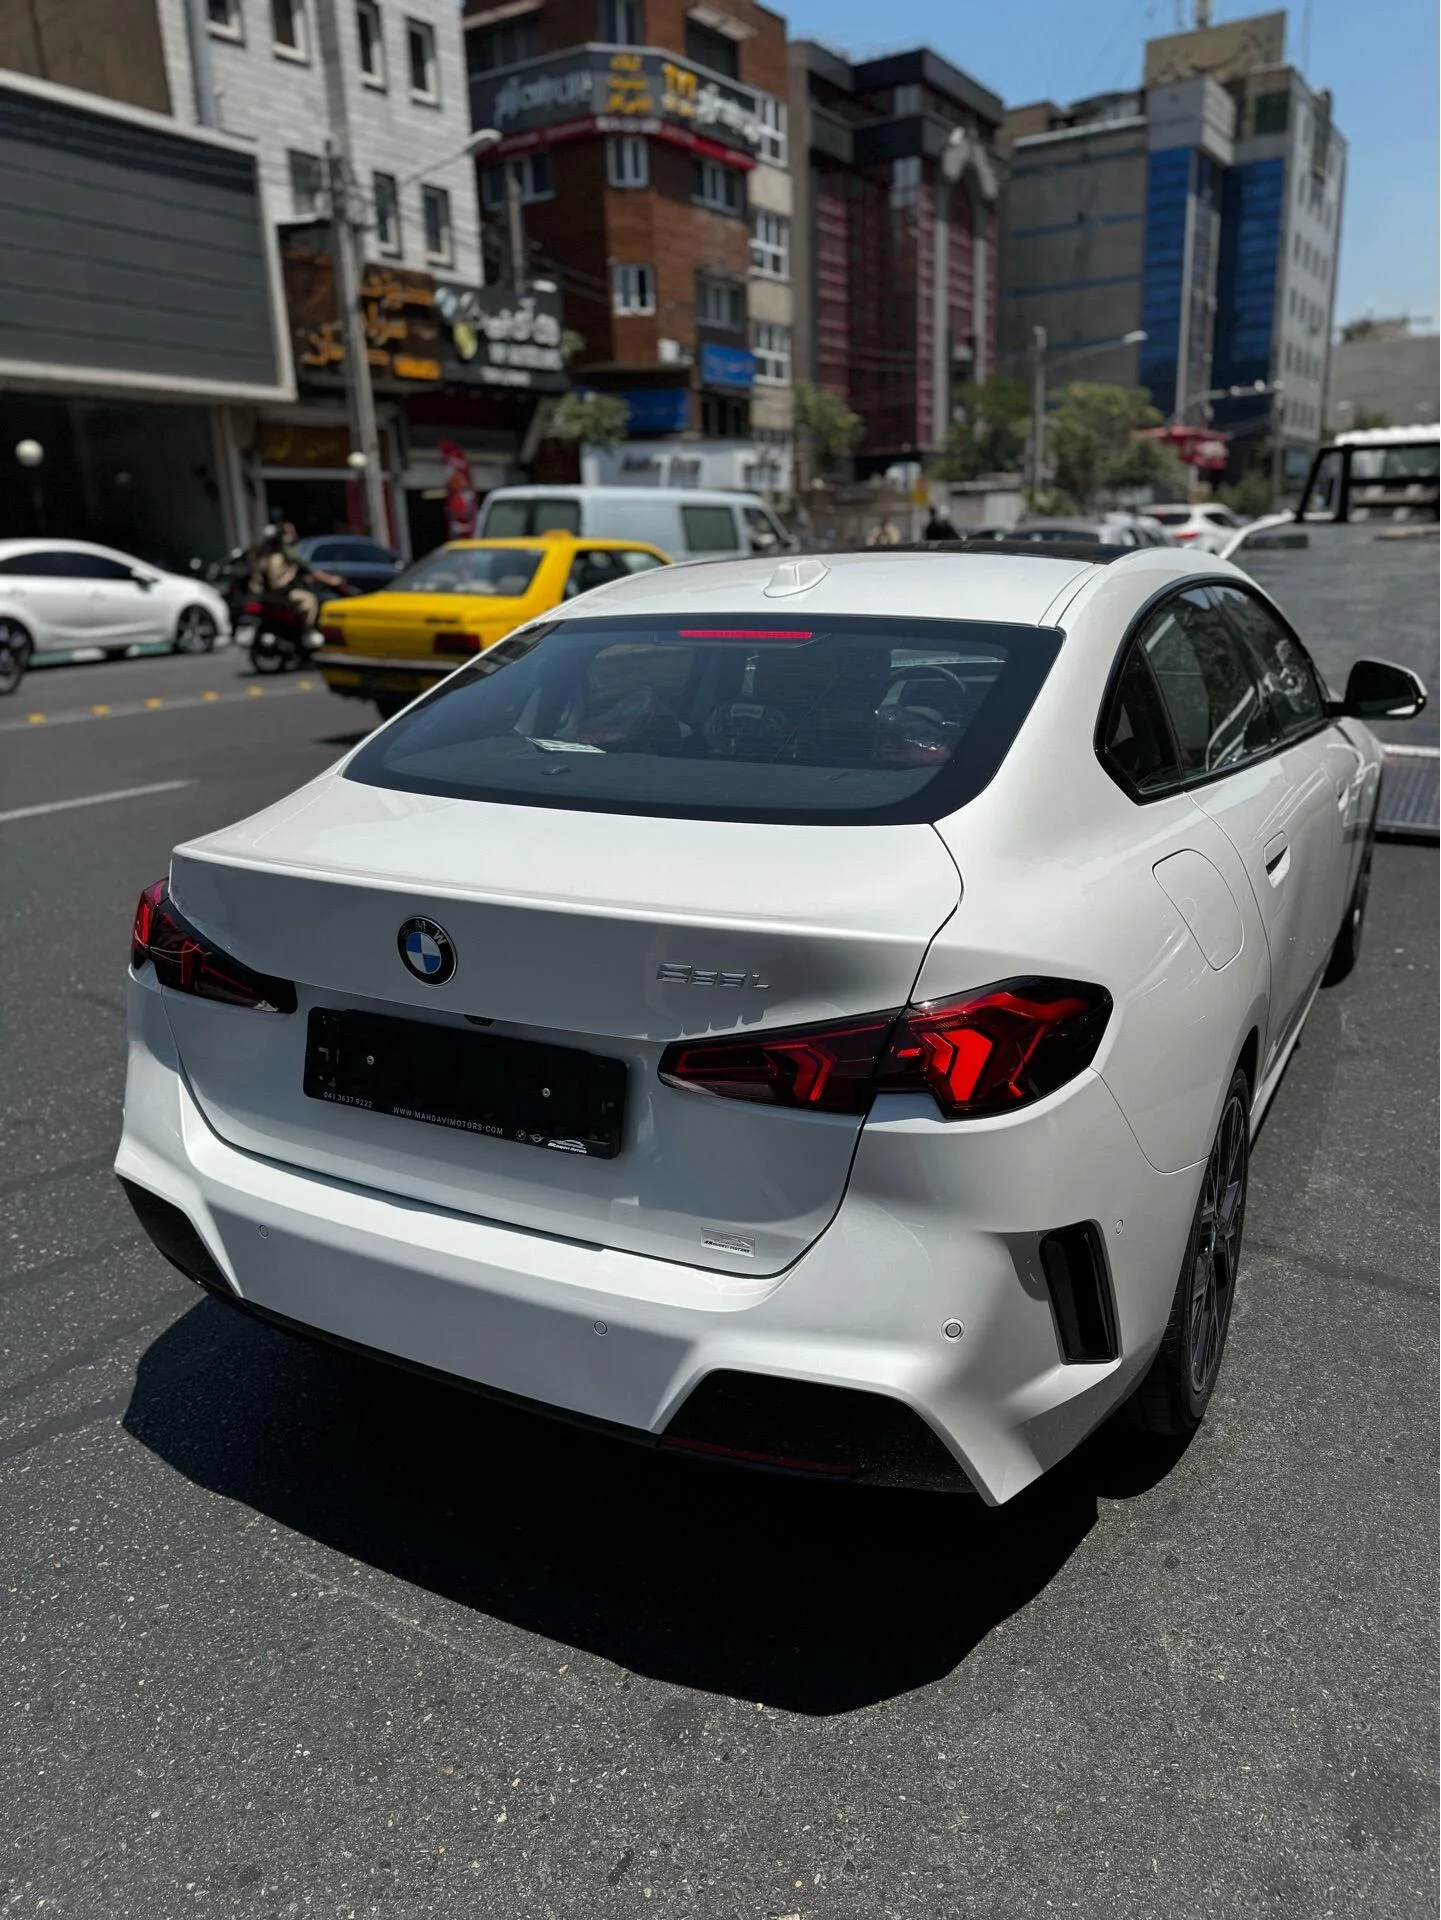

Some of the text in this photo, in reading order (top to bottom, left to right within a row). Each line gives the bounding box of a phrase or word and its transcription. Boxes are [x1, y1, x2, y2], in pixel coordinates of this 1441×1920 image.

[323, 1091, 373, 1108] 041 3637 9222
